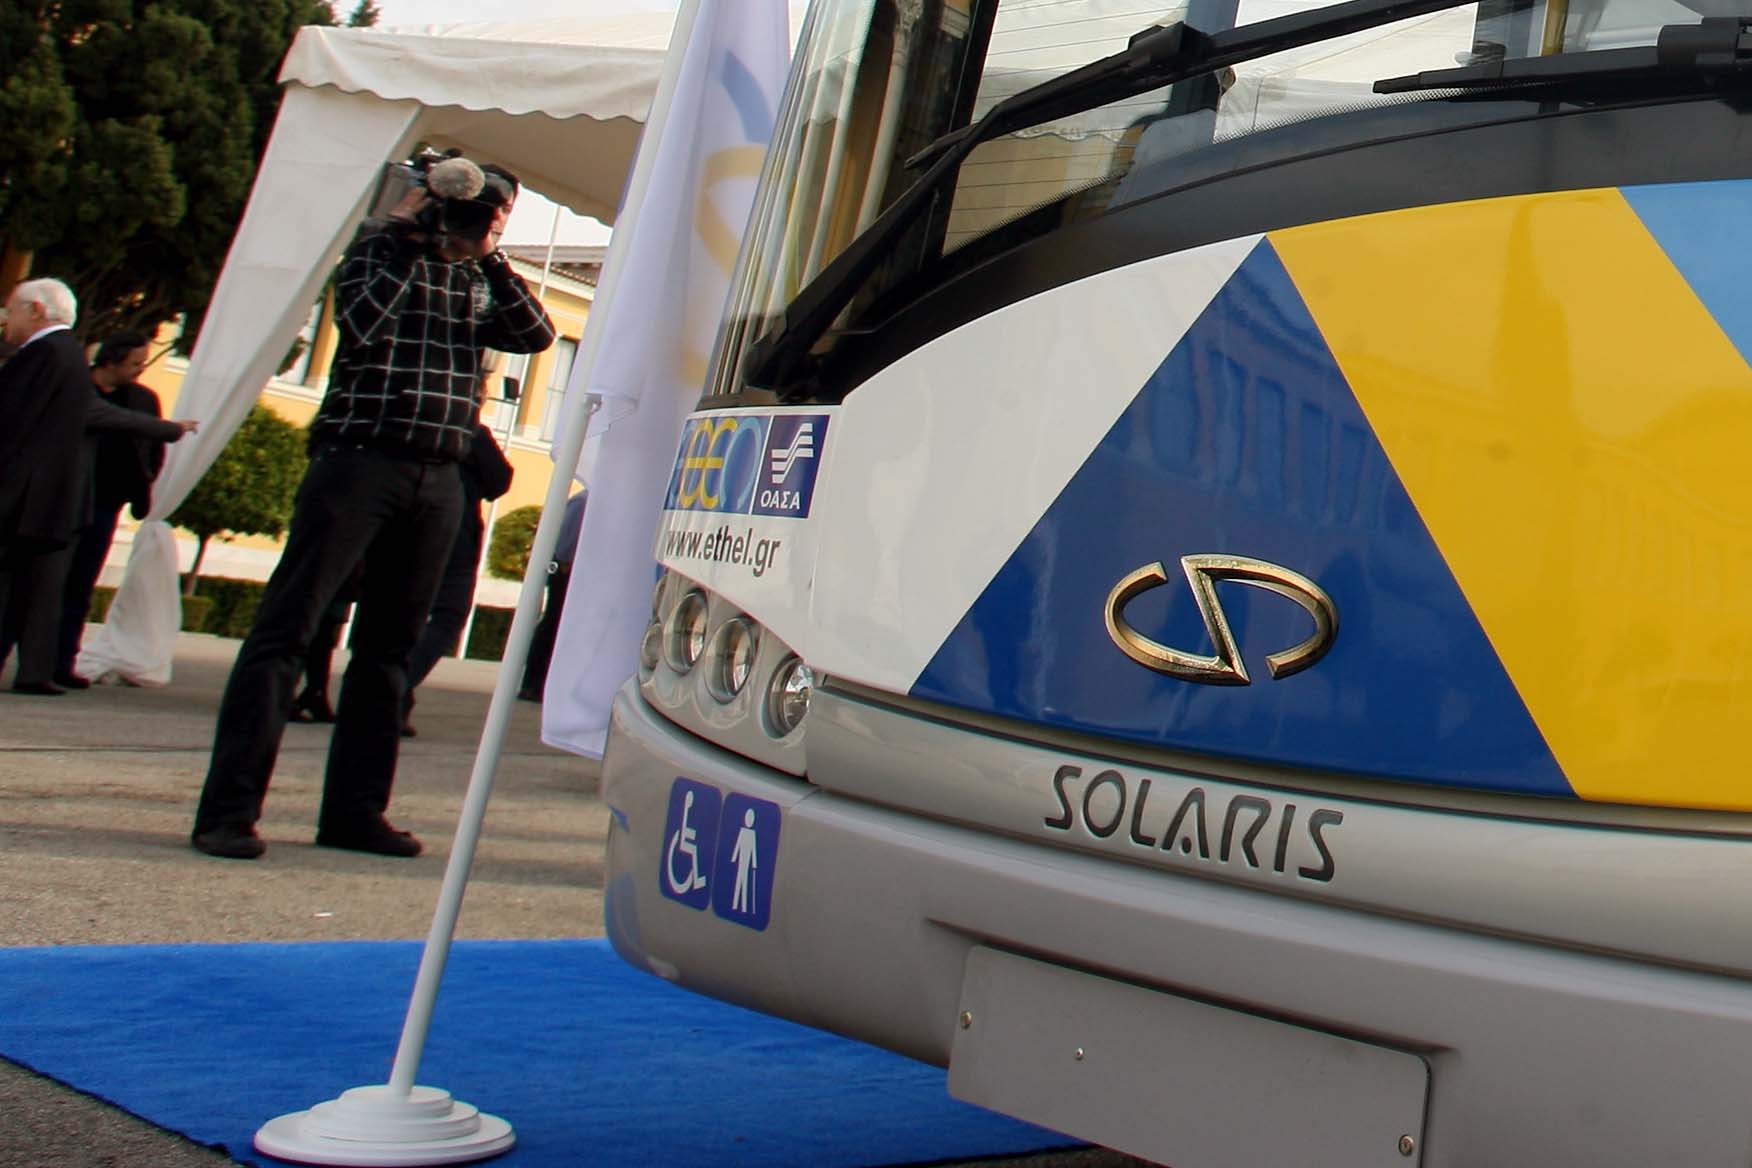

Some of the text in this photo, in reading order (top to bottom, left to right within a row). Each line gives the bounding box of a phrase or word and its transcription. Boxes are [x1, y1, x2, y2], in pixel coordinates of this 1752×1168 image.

[760, 489, 801, 510] ΟΑΣΑ
[665, 525, 781, 578] www.ethel.gr
[1043, 764, 1344, 883] SOLARIS
